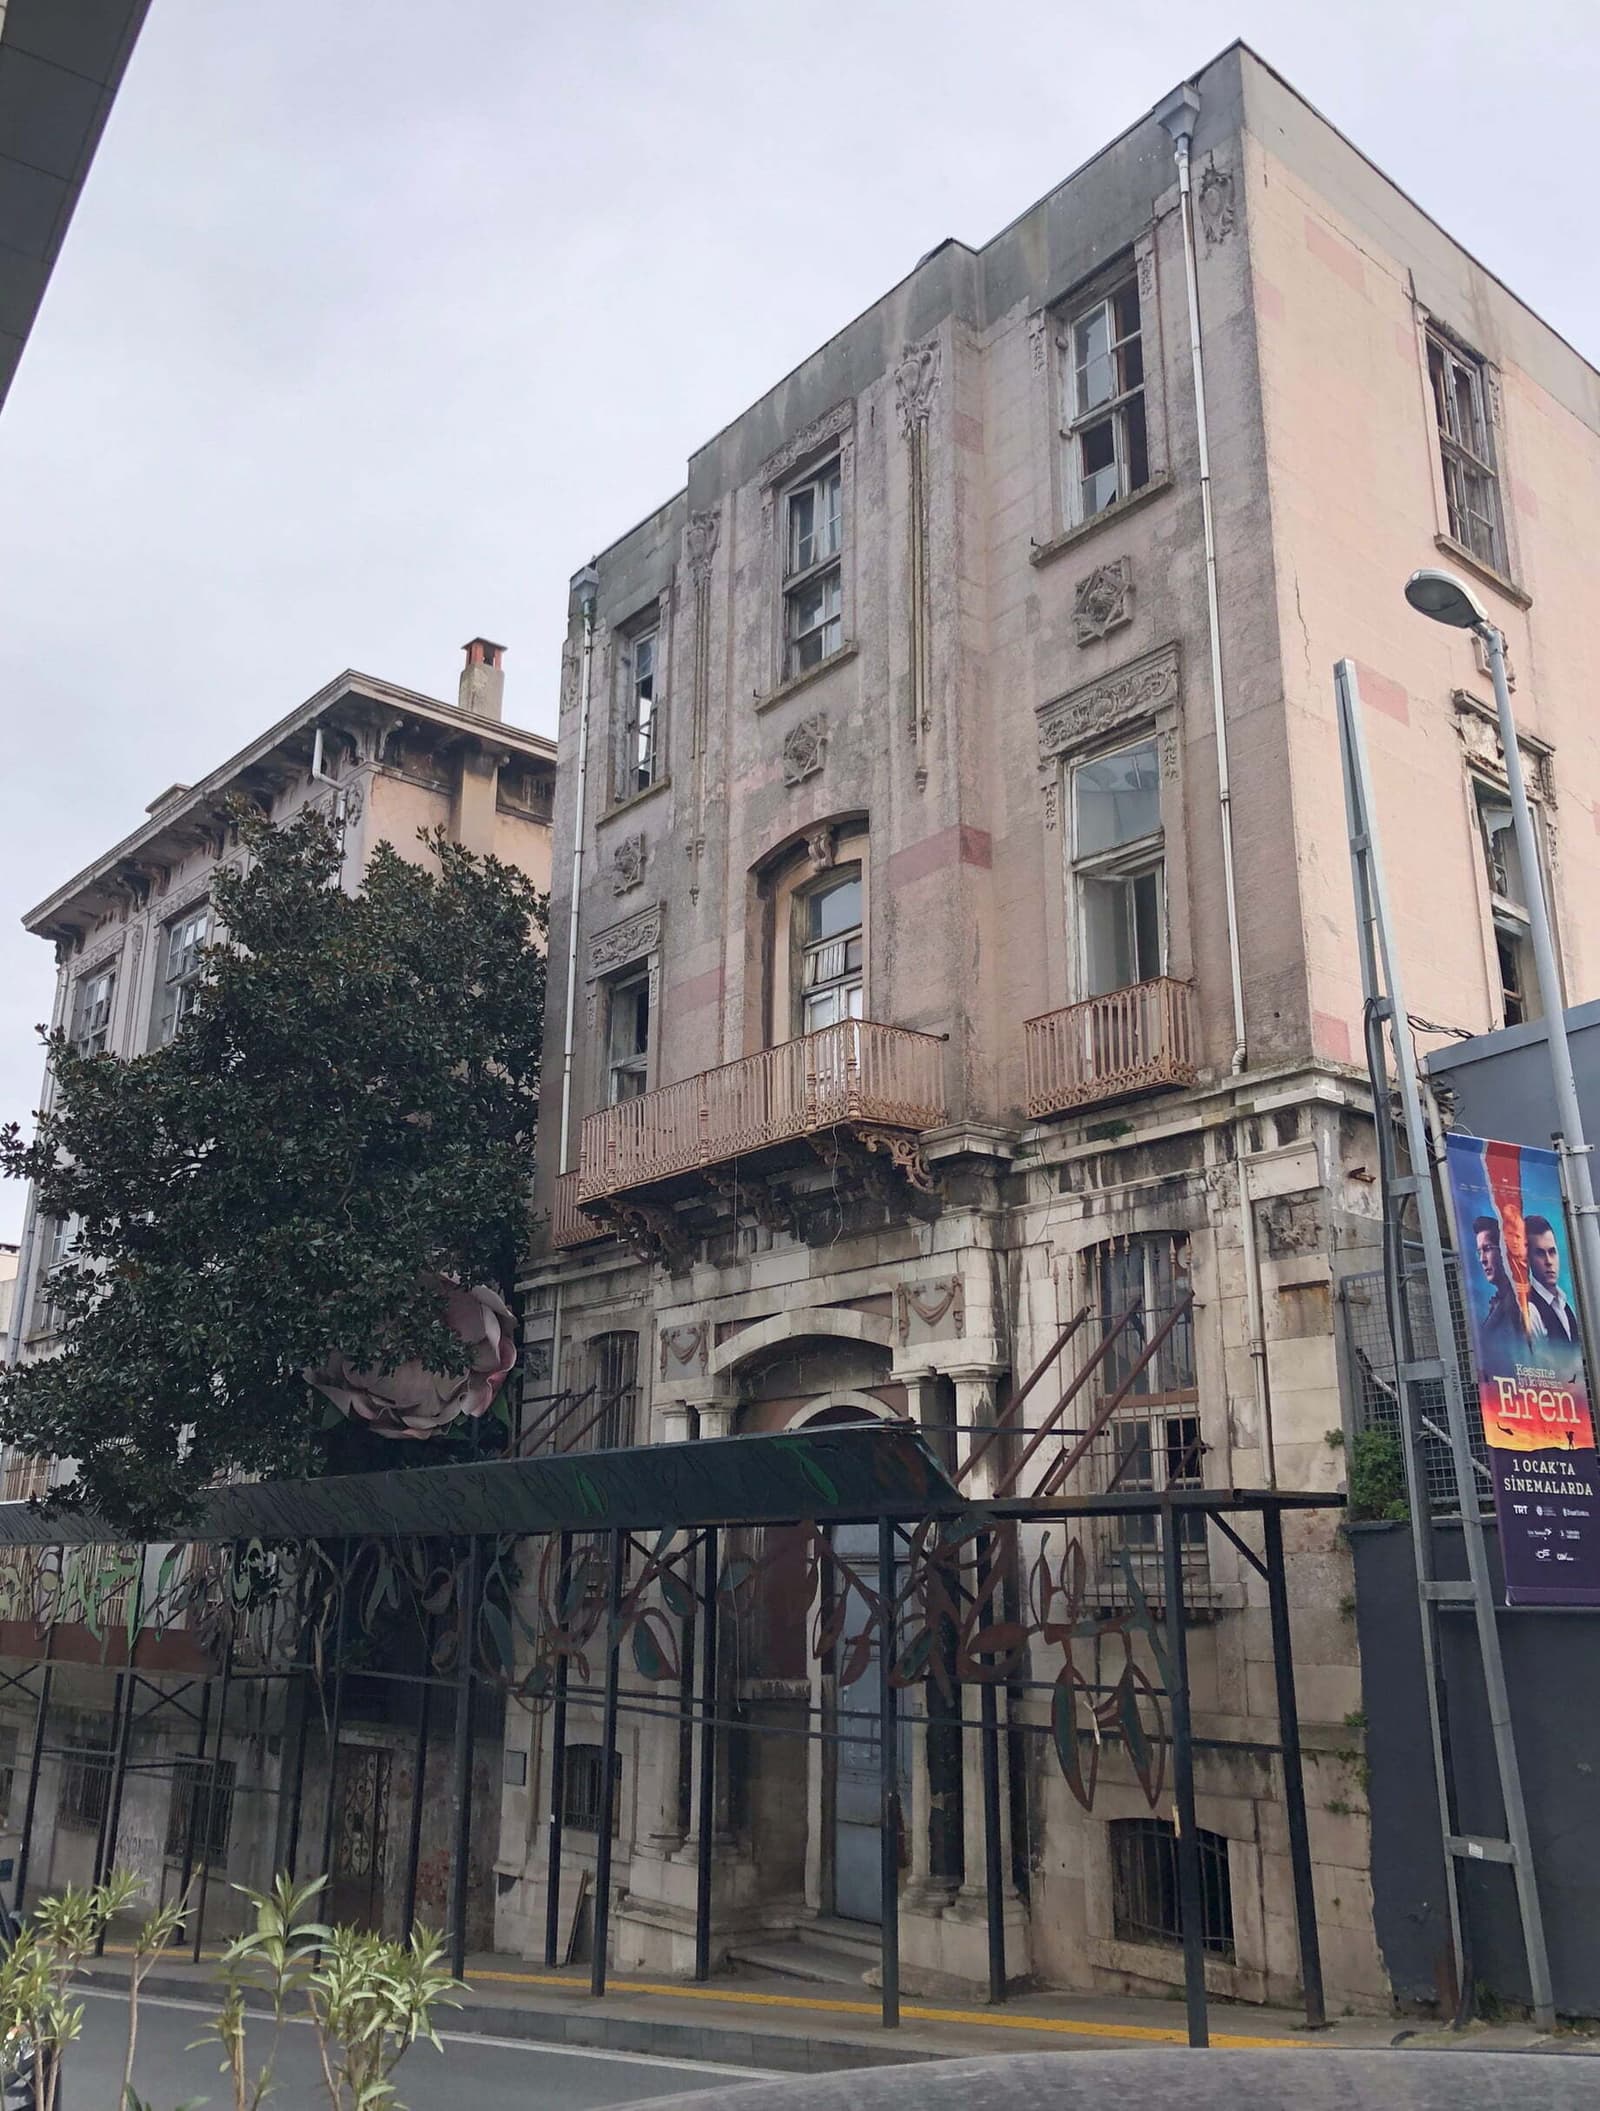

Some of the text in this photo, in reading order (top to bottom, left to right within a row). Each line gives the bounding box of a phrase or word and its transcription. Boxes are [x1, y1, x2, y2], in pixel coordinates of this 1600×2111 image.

[1493, 1375, 1581, 1424] Eren
[1512, 1458, 1576, 1476] 1 OCAK'TA
[1503, 1474, 1594, 1496] SİNEMALARDA
[1512, 1504, 1529, 1515] TRT
